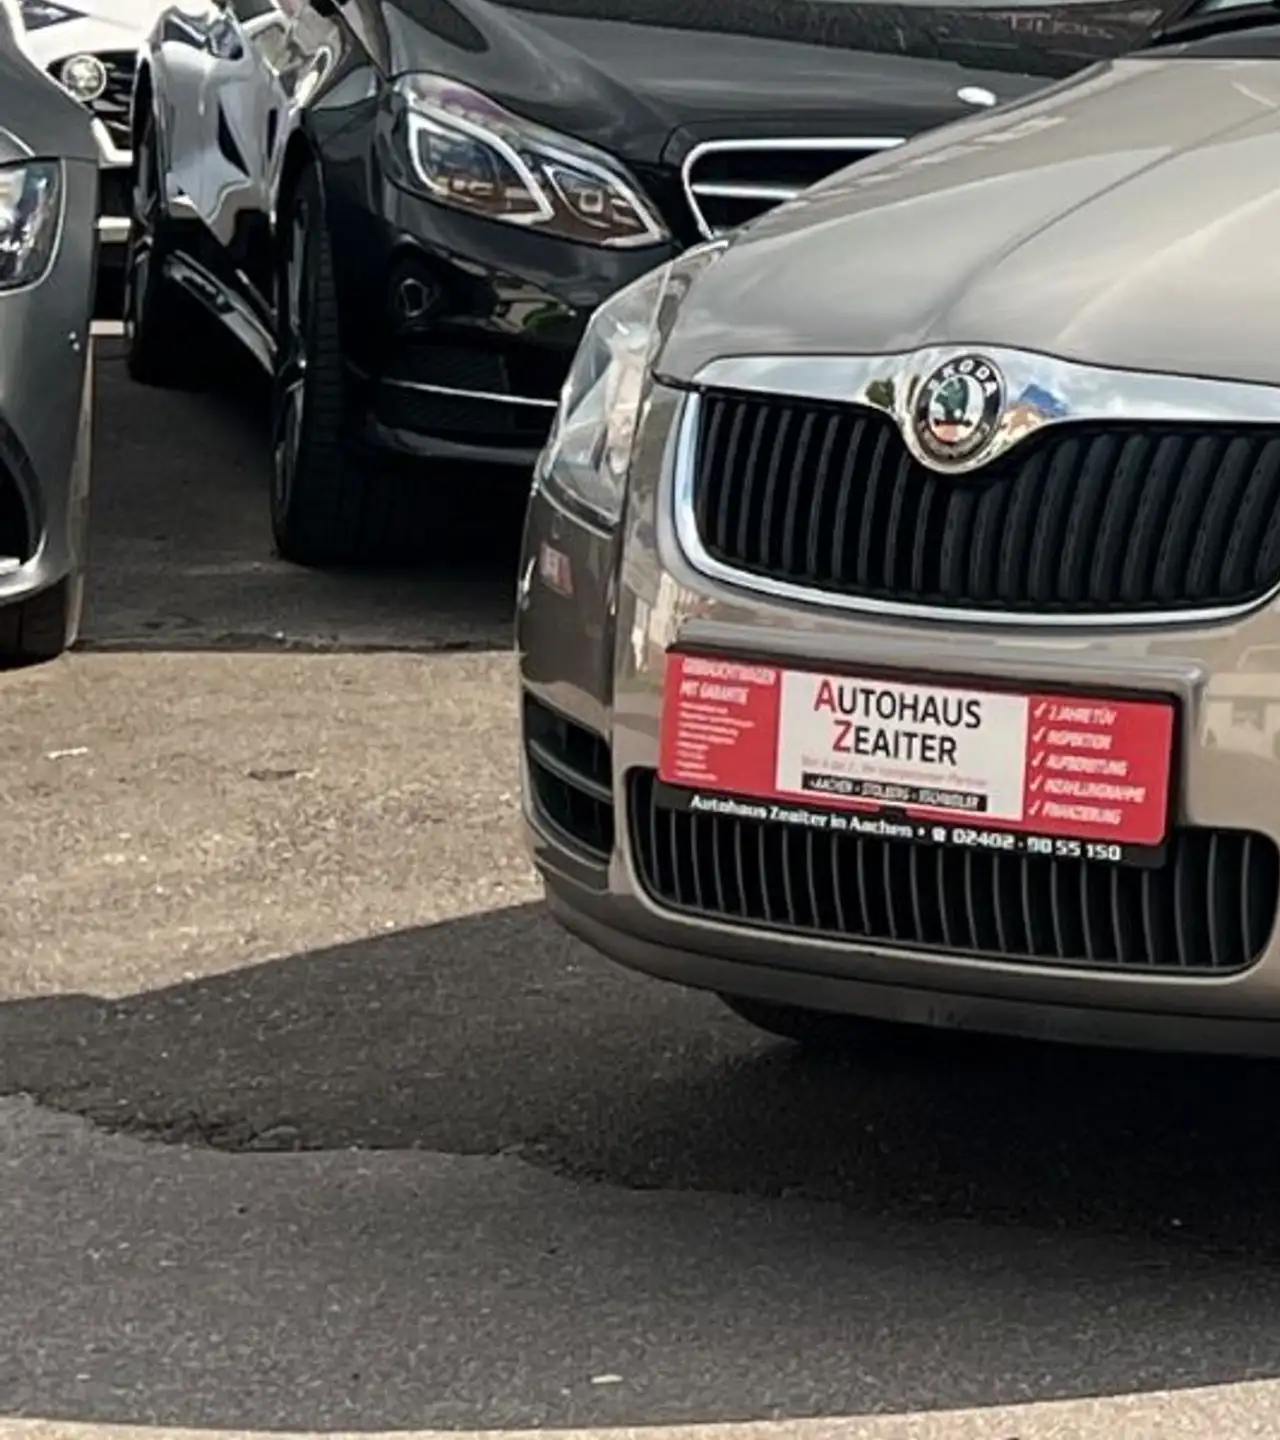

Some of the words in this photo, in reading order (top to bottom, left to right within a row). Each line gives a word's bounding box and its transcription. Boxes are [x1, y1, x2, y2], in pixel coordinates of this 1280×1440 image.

[814, 679, 981, 729] AUTOHAUS
[833, 720, 957, 766] ZEAITER
[690, 794, 767, 819] Autohaus
[850, 816, 914, 838] Aachen
[952, 828, 1015, 850] 02402
[1055, 840, 1081, 857] 55
[1086, 843, 1121, 861] 150
